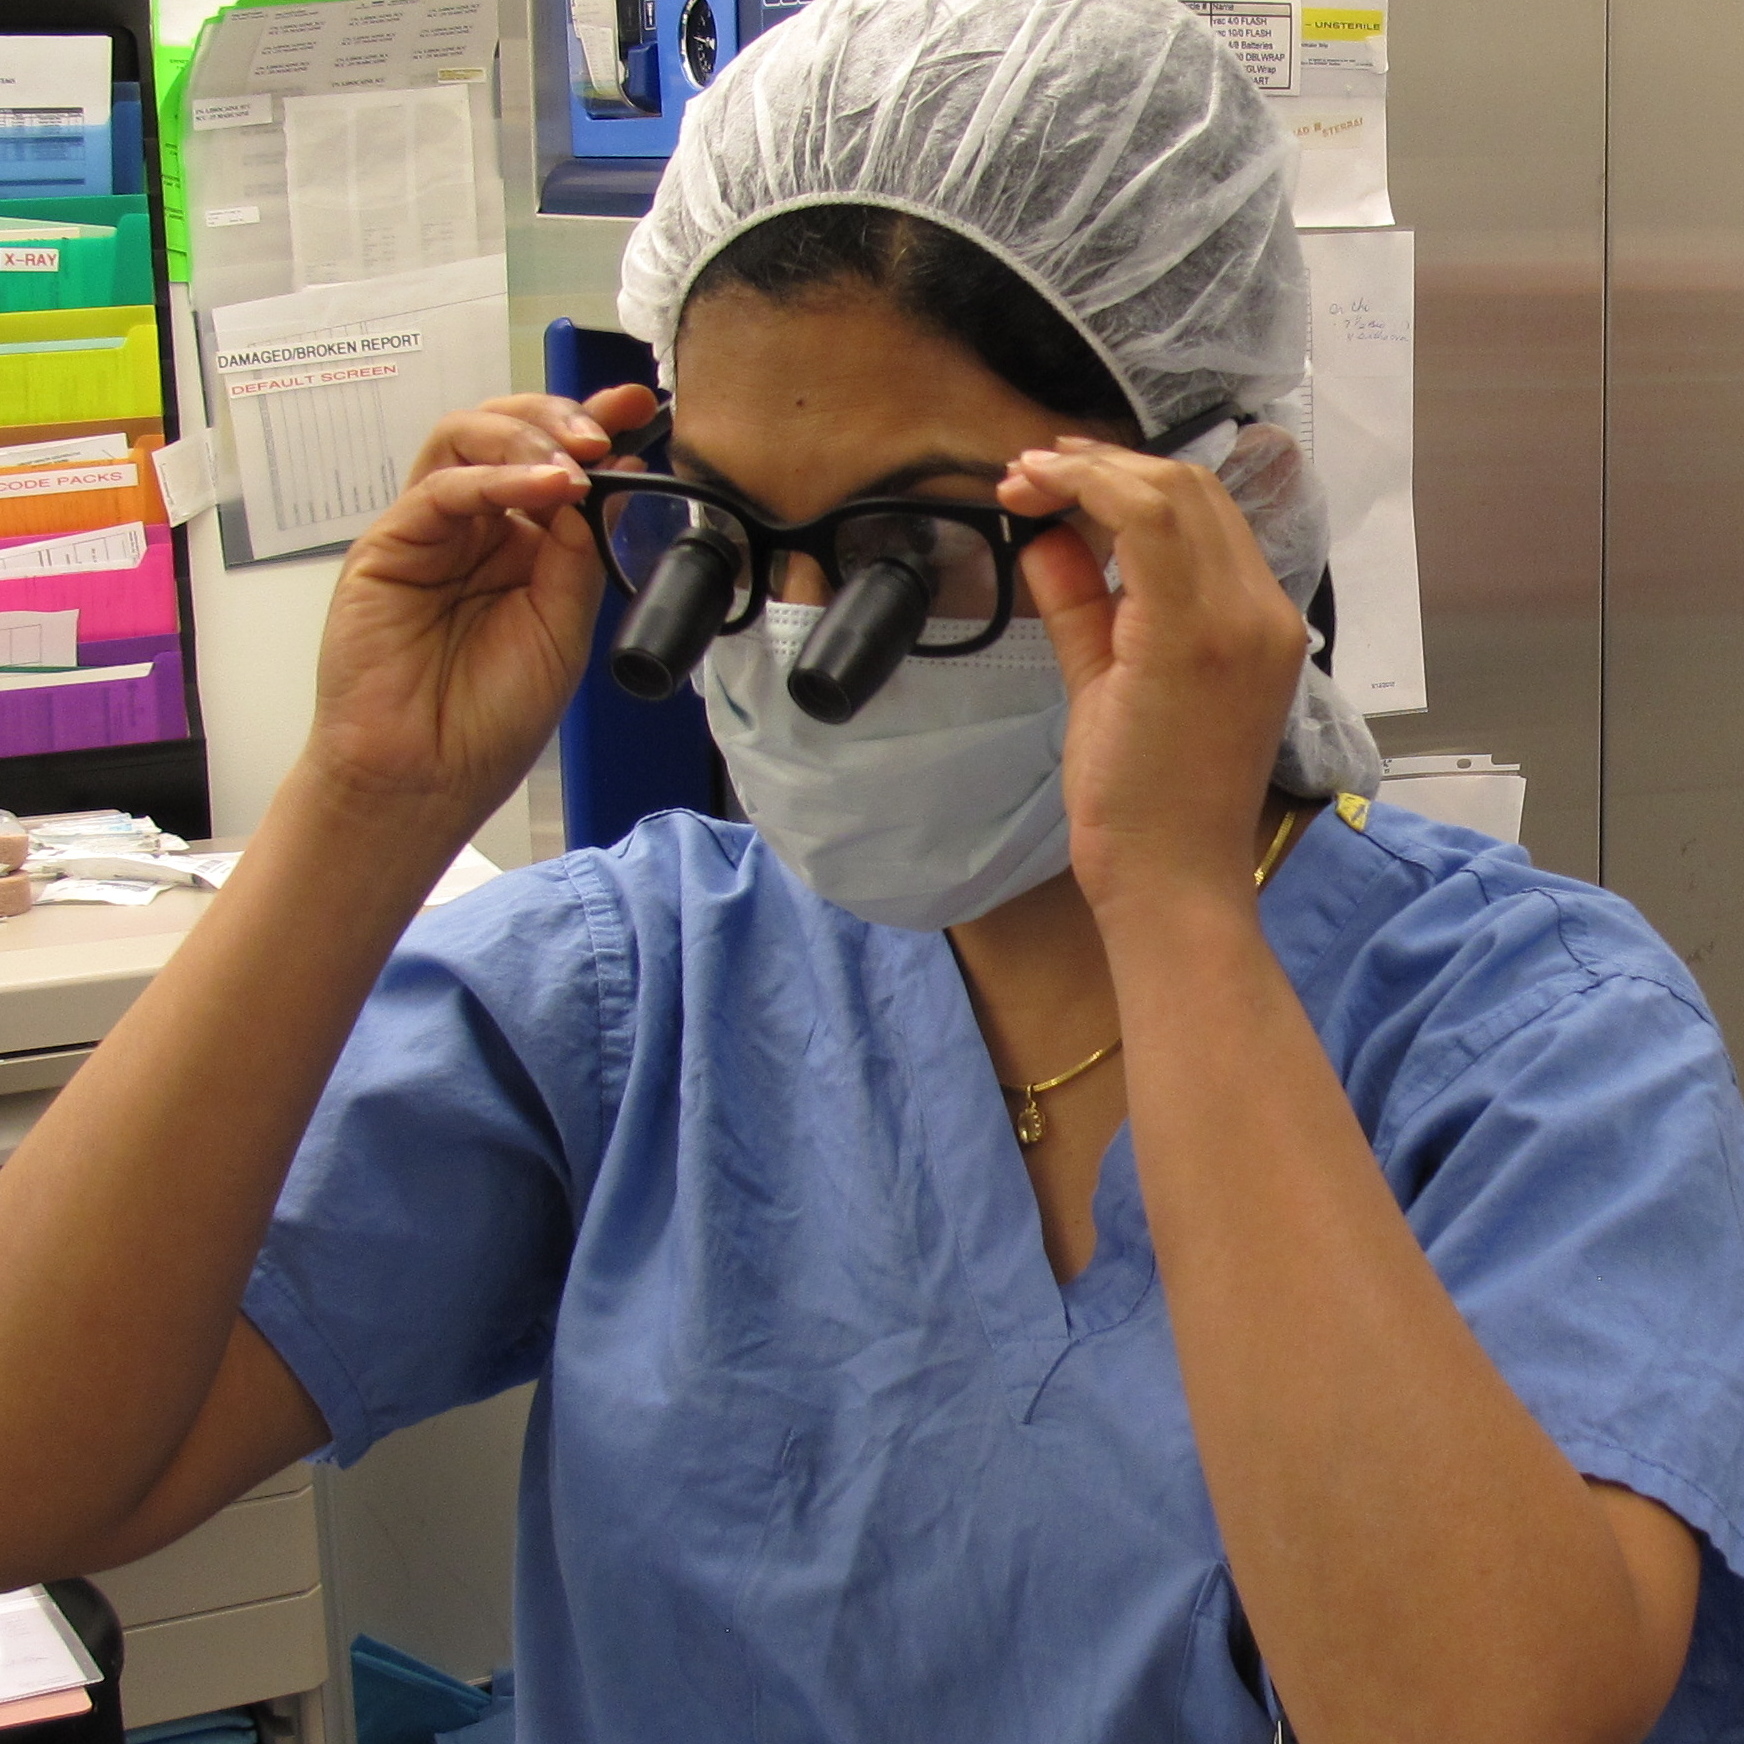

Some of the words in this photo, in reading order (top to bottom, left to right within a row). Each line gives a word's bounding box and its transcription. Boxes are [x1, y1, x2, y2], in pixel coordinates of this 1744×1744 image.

[1212, 3, 1234, 11] Name
[1315, 21, 1380, 31] UNSTERILE
[1241, 41, 1273, 50] Batteries
[4, 253, 57, 266] X-RAY
[218, 341, 357, 368] DAMAGED/BROKEN
[361, 333, 421, 351] REPORT
[231, 374, 316, 396] DEFAULT
[320, 365, 397, 383] SCREEN
[57, 471, 123, 486] PACKS
